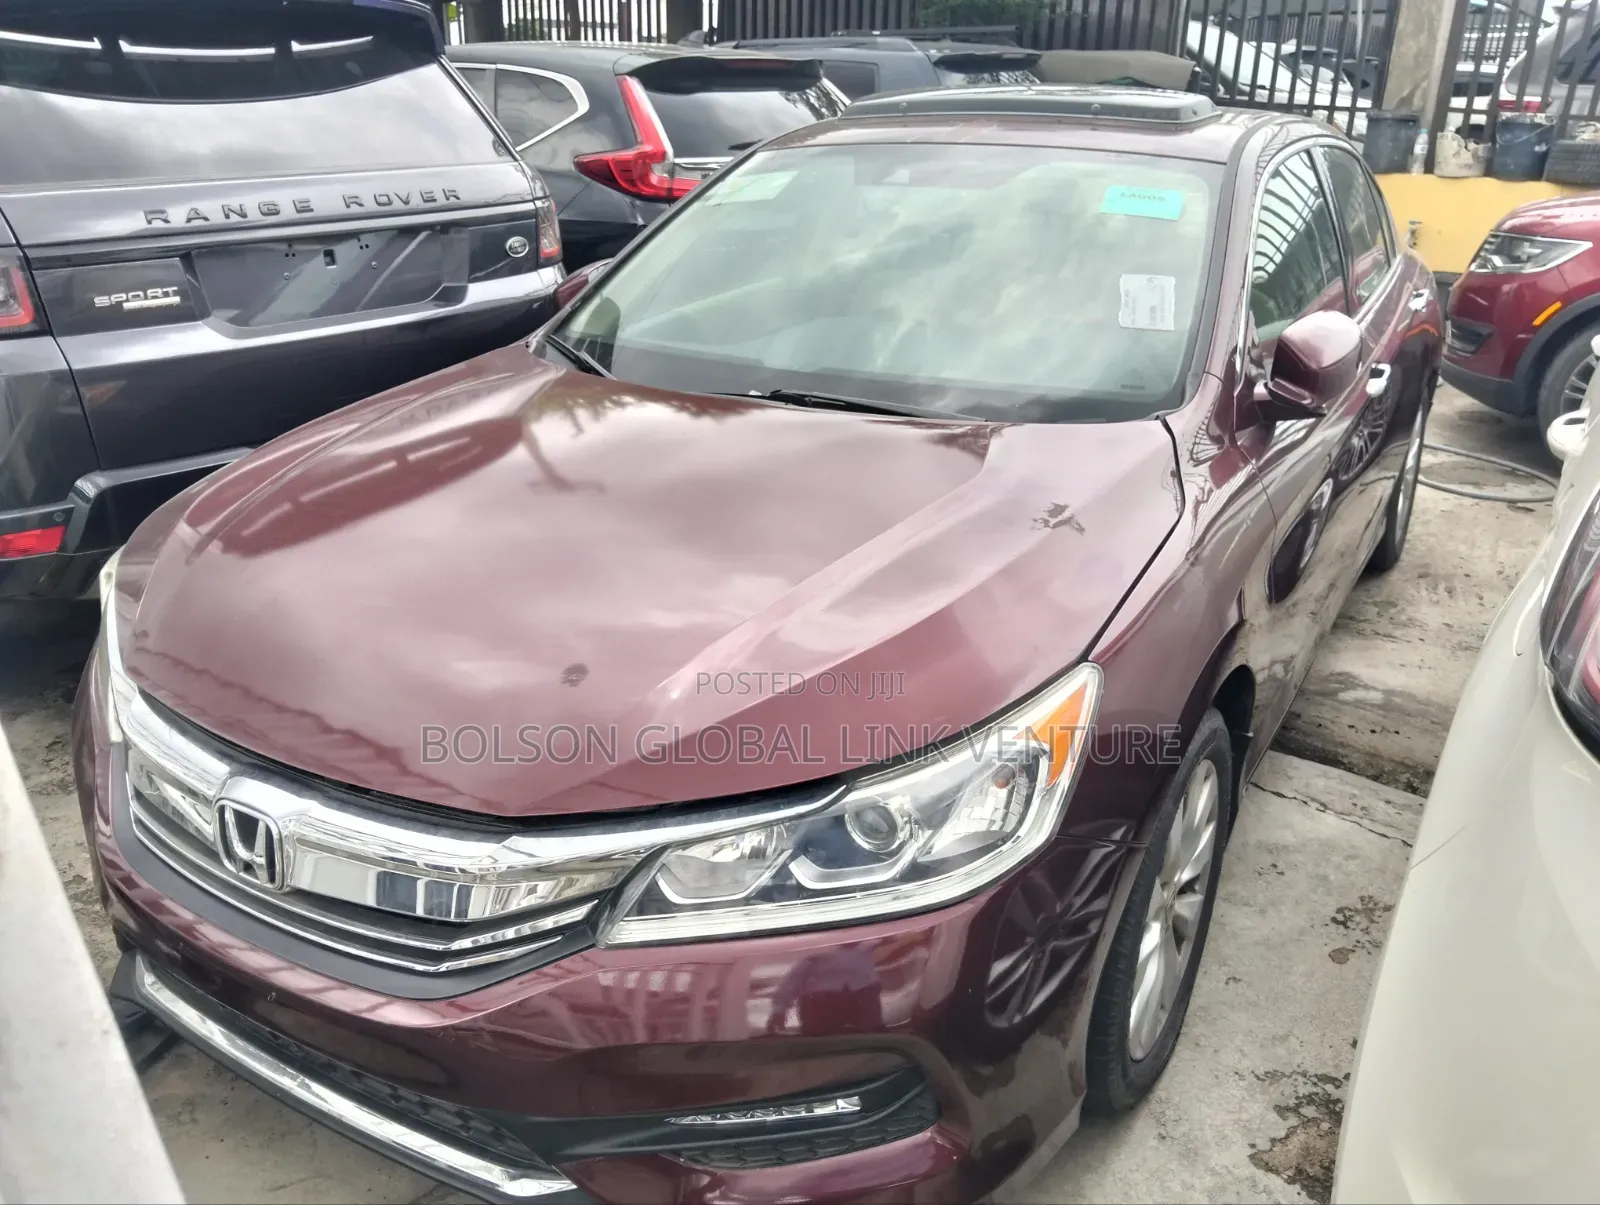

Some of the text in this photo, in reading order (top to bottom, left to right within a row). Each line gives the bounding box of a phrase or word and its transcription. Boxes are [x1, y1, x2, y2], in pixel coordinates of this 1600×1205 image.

[143, 188, 462, 225] RANGE ROVER
[93, 286, 178, 307] SPORT
